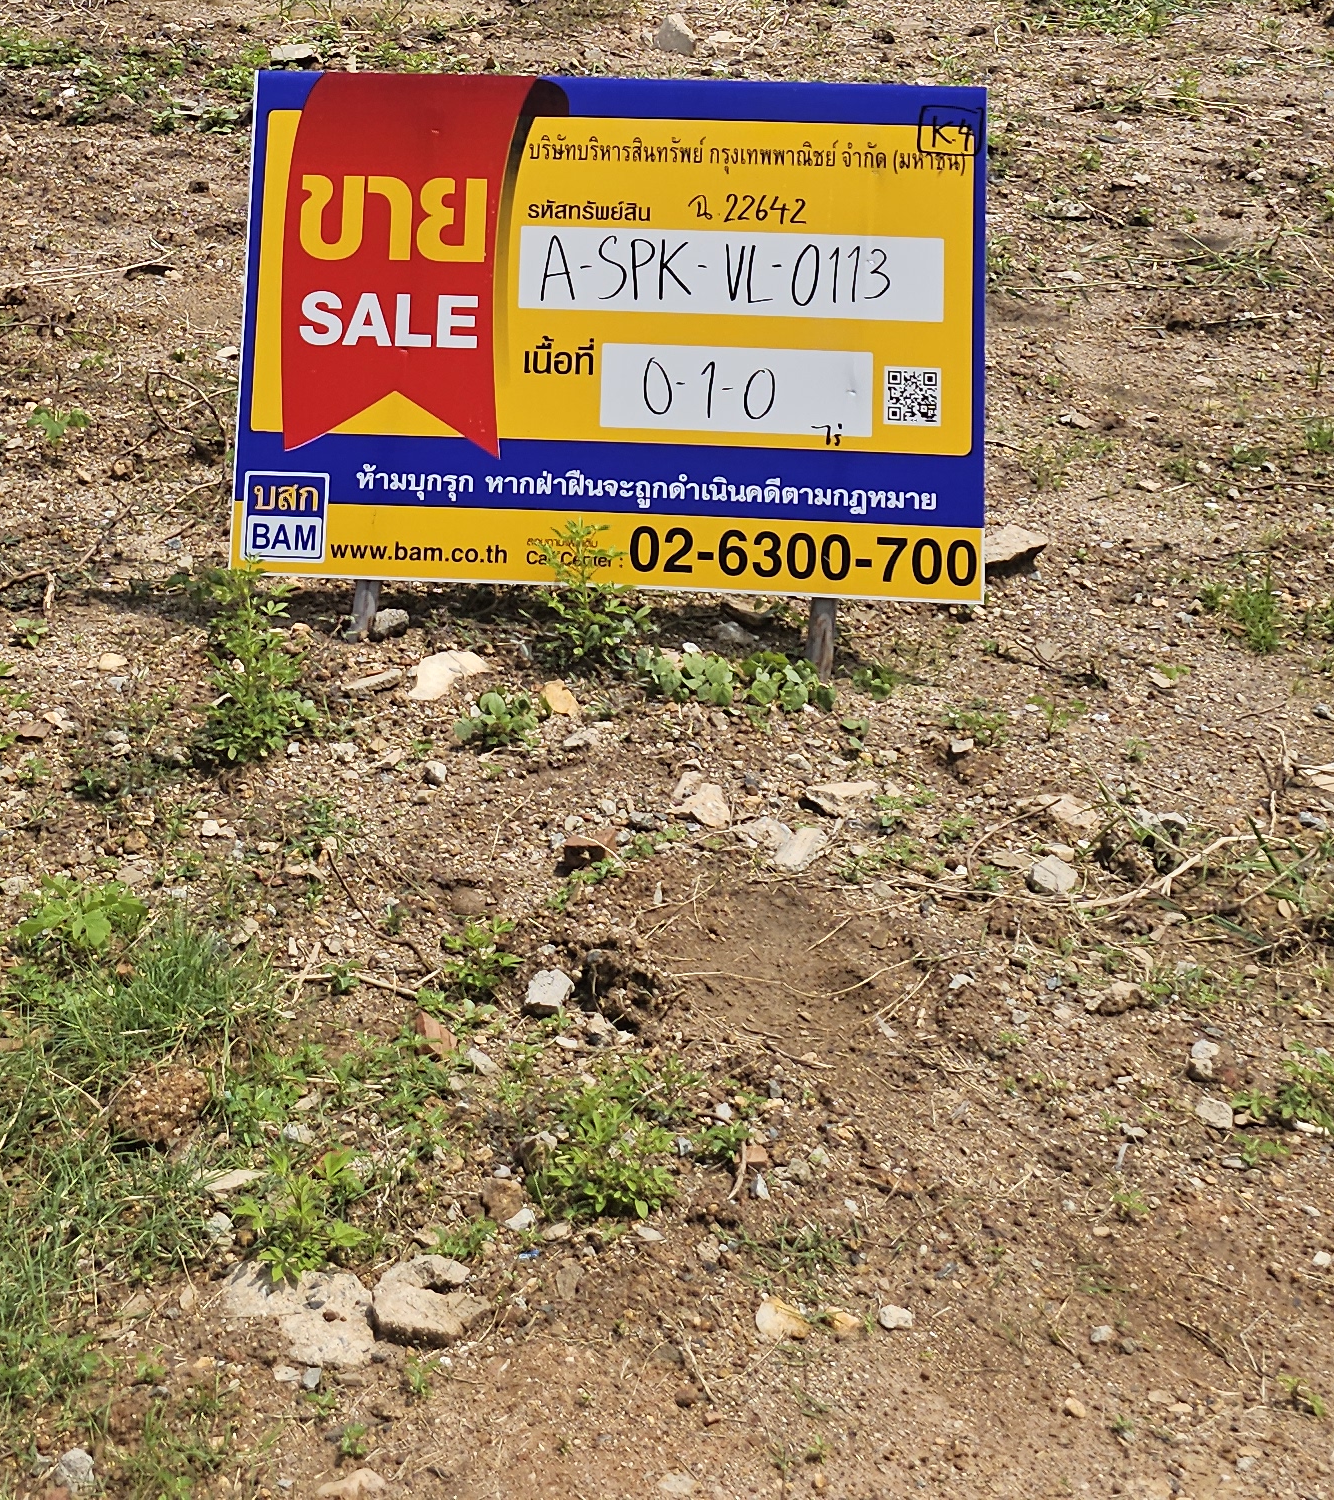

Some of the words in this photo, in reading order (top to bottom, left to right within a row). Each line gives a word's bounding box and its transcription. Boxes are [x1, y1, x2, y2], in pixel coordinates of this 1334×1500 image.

[529, 134, 706, 163] บริษัทบริหารสินทรัพย์
[709, 140, 839, 175] กรุงเทพพาณิชย์
[841, 141, 887, 169] จำกัด
[299, 174, 488, 263] ขาย
[527, 199, 651, 222] รหัสทรัพย์สิน
[299, 290, 479, 349] SALE
[523, 336, 595, 376] เนื้อที่
[252, 483, 319, 512] บสก
[356, 463, 474, 502] ห้ามบุกรุก
[251, 522, 317, 551] BAM
[330, 540, 508, 564] www.bam.co.th
[526, 550, 560, 565] Ca
[629, 524, 978, 587] 02-6300-700
